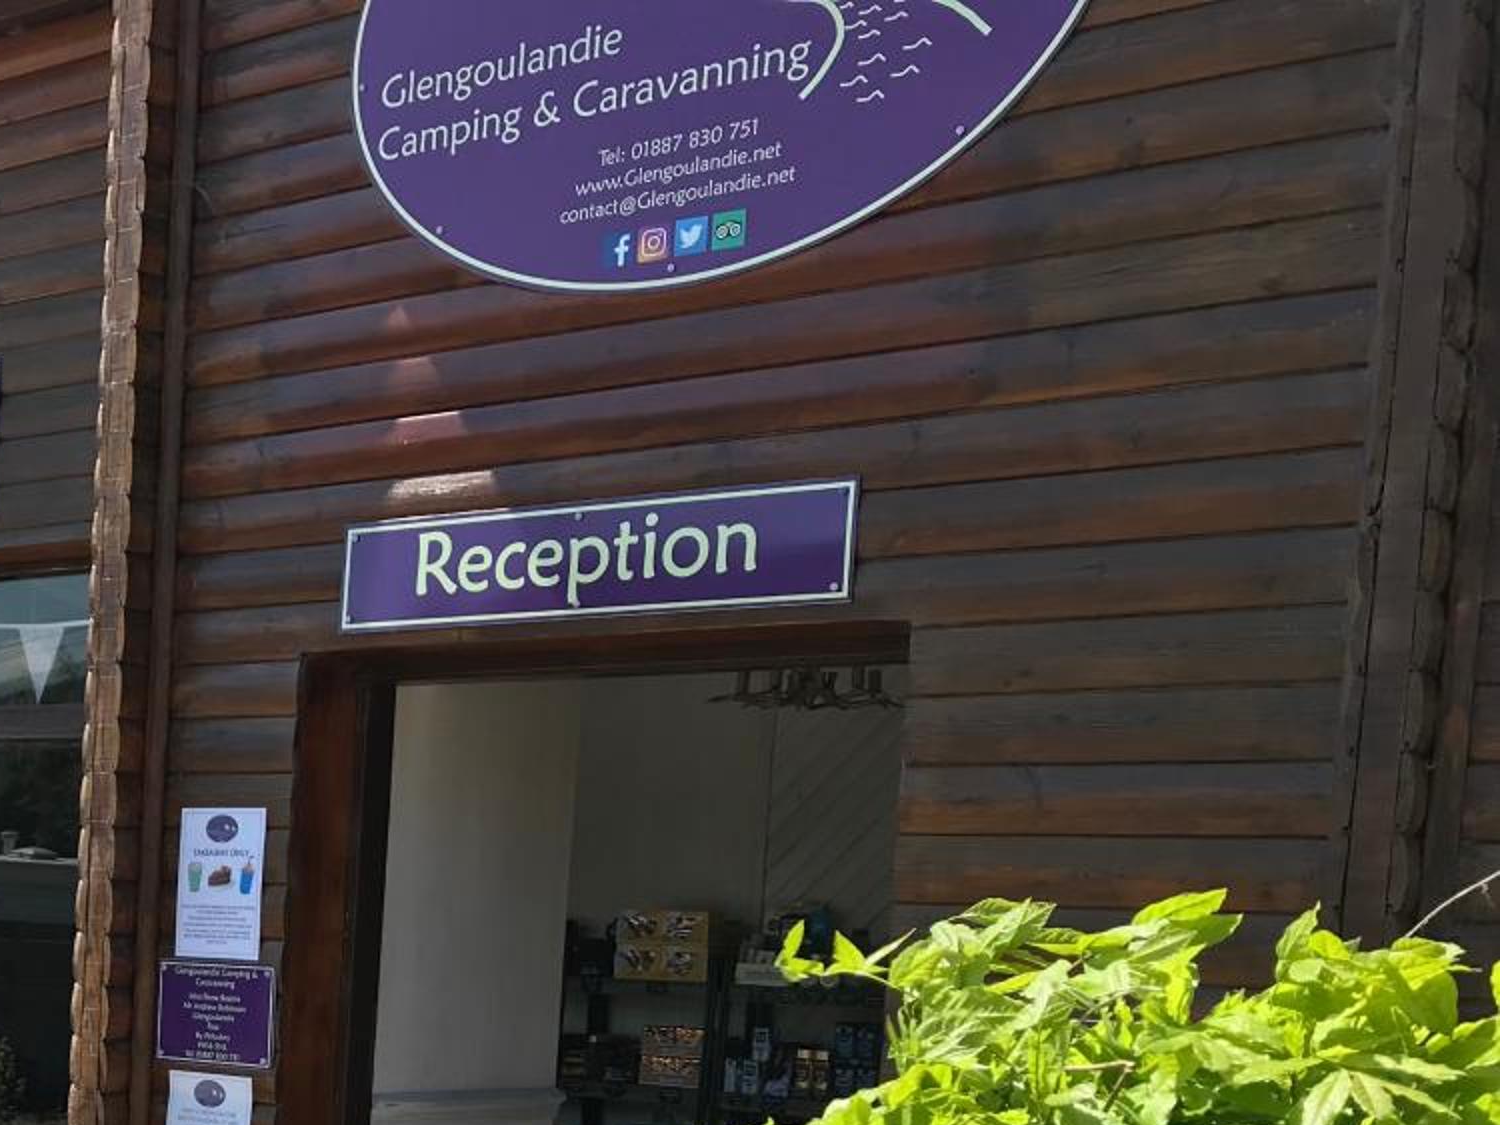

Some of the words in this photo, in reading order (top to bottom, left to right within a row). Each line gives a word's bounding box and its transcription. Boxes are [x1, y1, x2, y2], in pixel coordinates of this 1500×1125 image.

[378, 105, 523, 160] Camping
[533, 91, 561, 128] &
[572, 39, 813, 118] Caravanning
[381, 25, 623, 108] Glengoulandie
[575, 141, 782, 196] www.Glengoulandie.net
[598, 146, 626, 167] Tel:
[631, 134, 683, 160] 01887
[689, 125, 723, 149] 830
[729, 117, 759, 141] 751
[560, 166, 796, 224] contact@Glengoulandie.net
[415, 512, 758, 607] Reception
